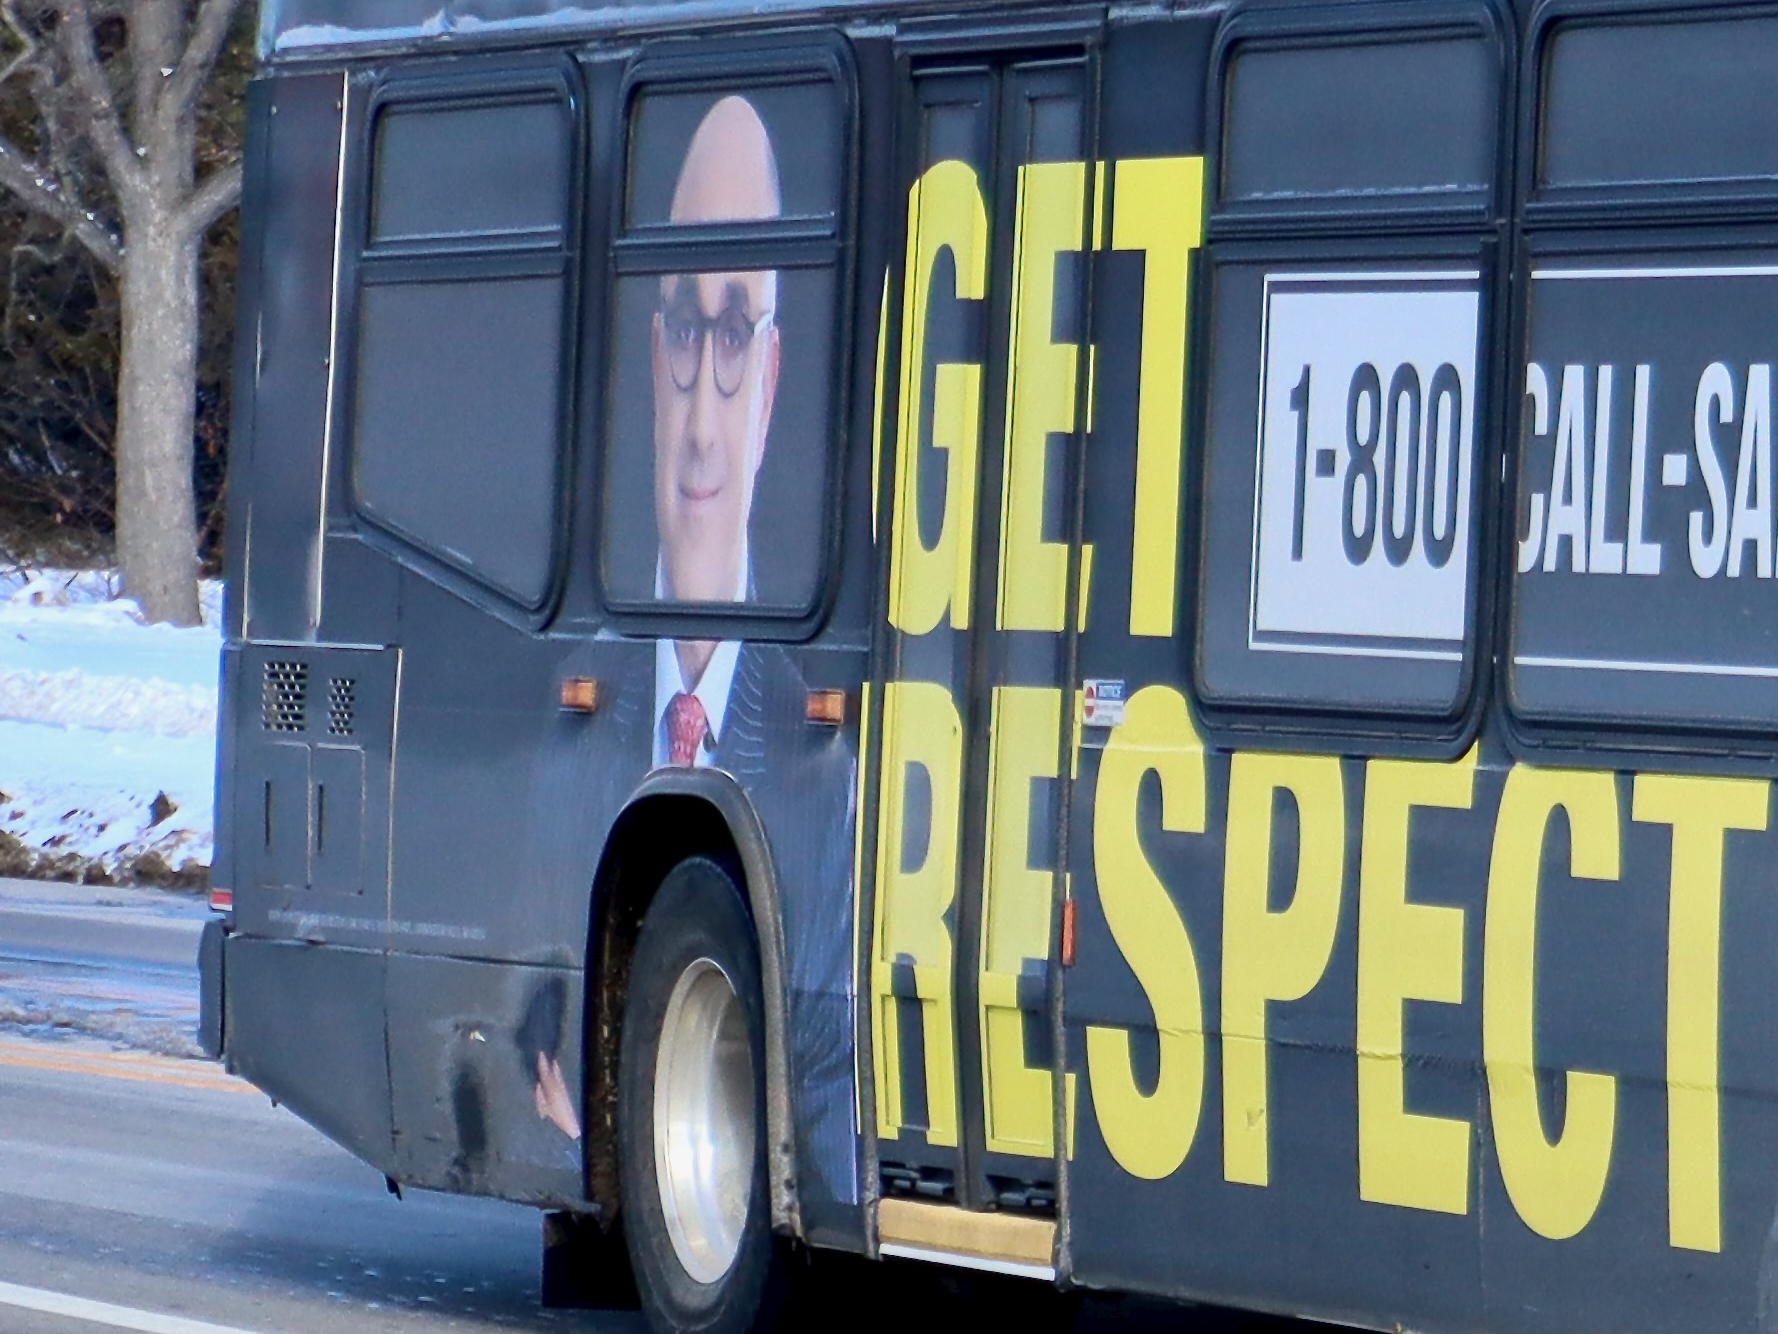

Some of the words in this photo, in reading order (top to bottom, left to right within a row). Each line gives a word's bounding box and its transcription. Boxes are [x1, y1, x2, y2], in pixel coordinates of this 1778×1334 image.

[872, 156, 1204, 637] GET
[1289, 361, 1463, 569] 1-800
[855, 681, 1769, 1253] RESPECT
